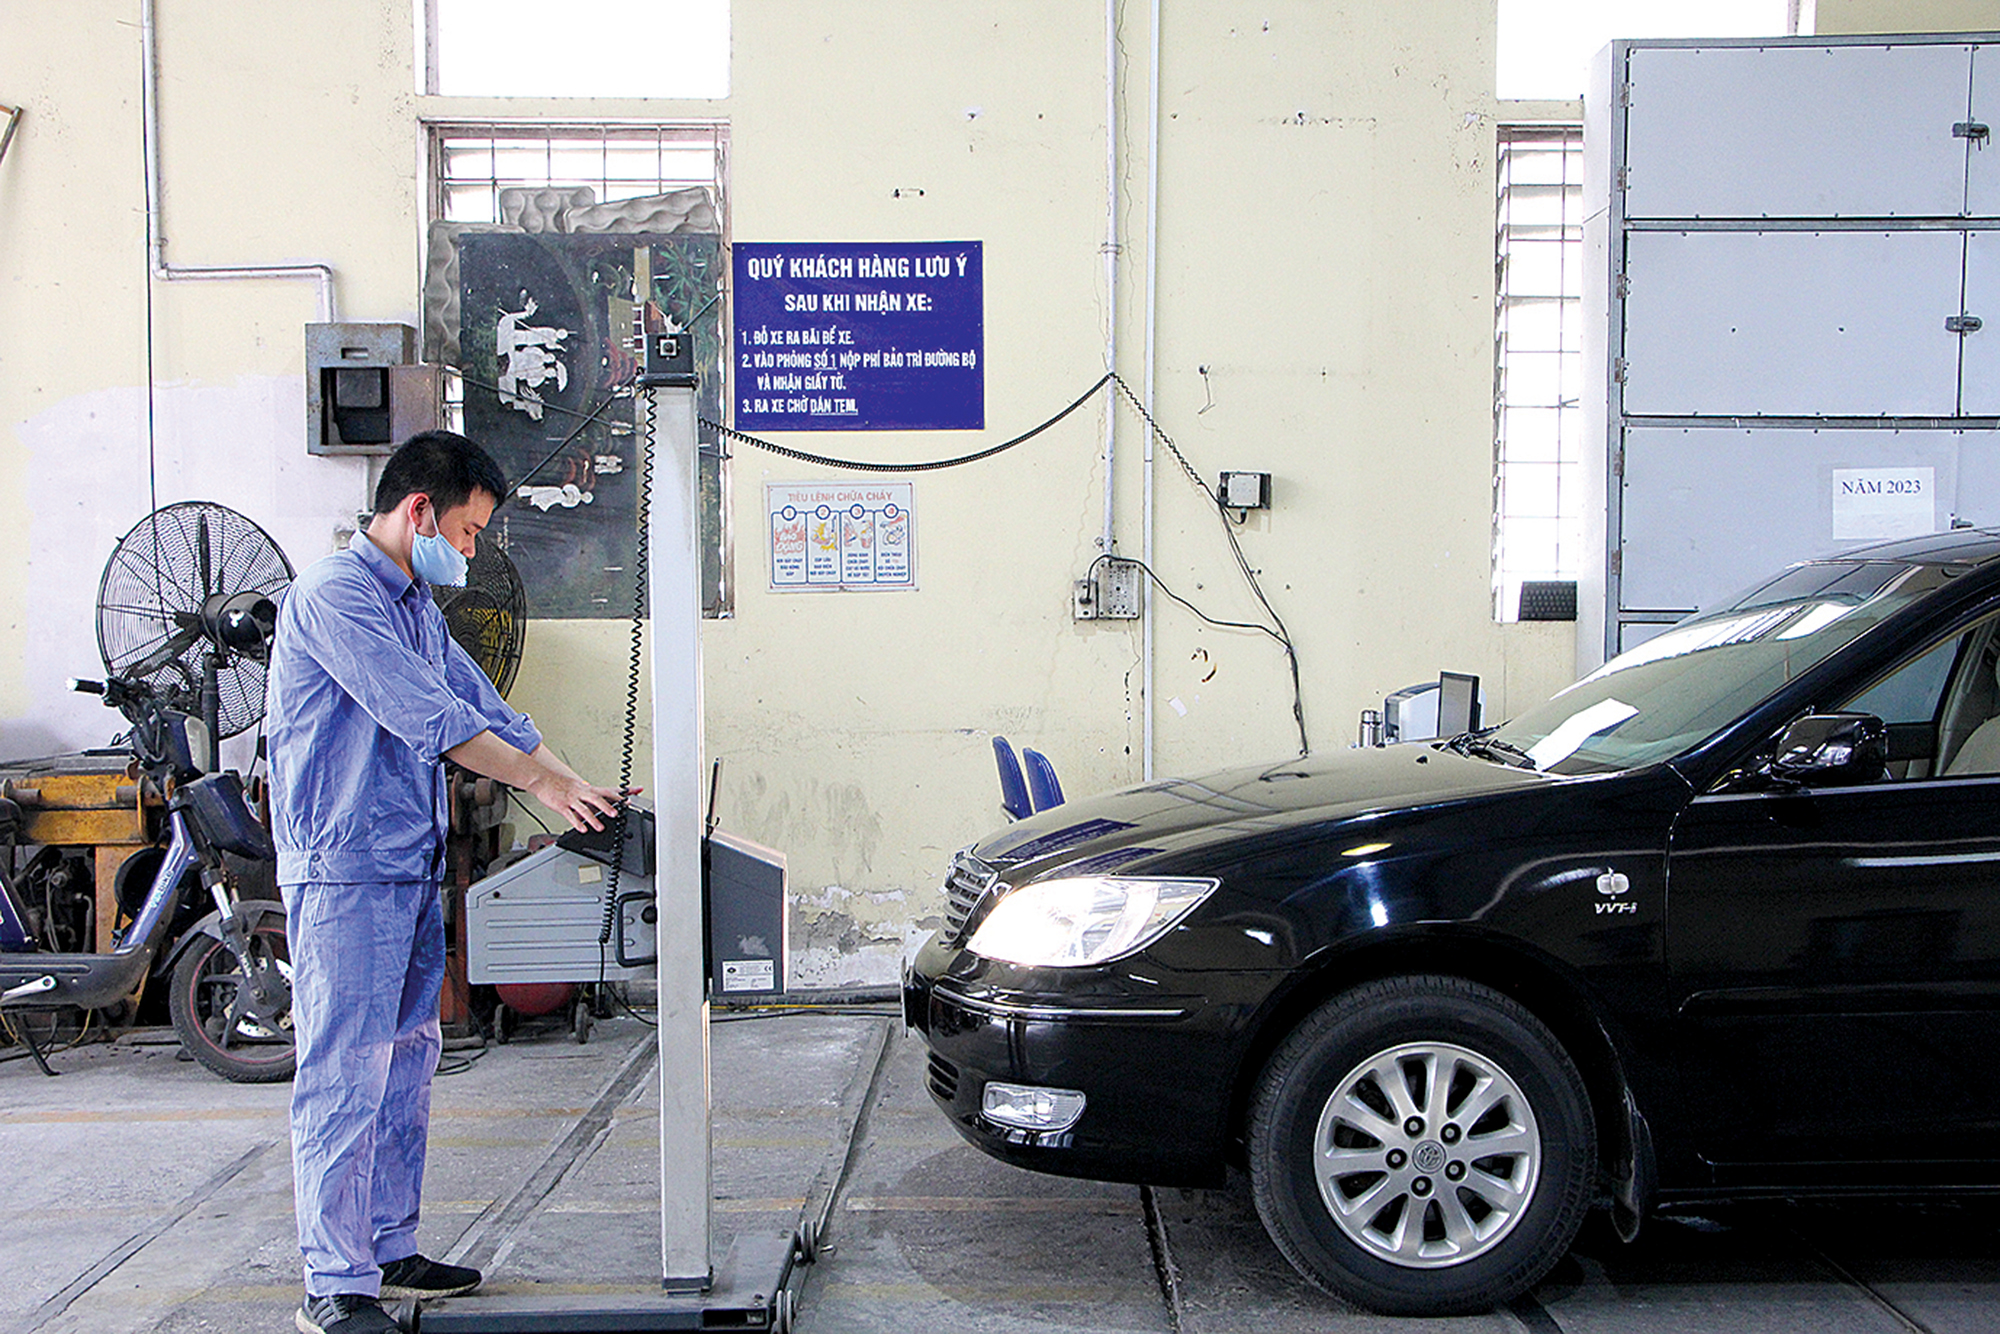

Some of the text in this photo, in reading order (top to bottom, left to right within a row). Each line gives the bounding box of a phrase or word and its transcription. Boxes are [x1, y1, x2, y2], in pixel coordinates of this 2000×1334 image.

[747, 253, 967, 281] QUÝ KHÁCH HÀNG LƯU Ý
[784, 290, 932, 316] SAU KHI NHẬN XE:
[742, 331, 752, 345] 1.
[770, 331, 784, 345] XE
[786, 331, 800, 345] RA
[802, 328, 820, 345] BÃI
[838, 331, 855, 345] XE.
[742, 353, 752, 368] 2.
[754, 350, 774, 368] VÀO
[776, 350, 812, 368] PHÒNG
[814, 348, 828, 368] SỐ
[831, 354, 836, 367] 1
[840, 350, 860, 370] NỘP
[863, 350, 880, 368] PHÍ
[905, 350, 922, 368] TRÌ
[924, 348, 960, 367] ĐƯỜNG
[961, 350, 976, 369] BỘ
[757, 371, 847, 394] VÀ NHẬN GIẤY TỜ.
[742, 395, 858, 413] 3. RA XE CHỜ DÁN TEM.
[1842, 478, 1921, 494] NĂM 2023
[1595, 902, 1638, 914] VVT-i
